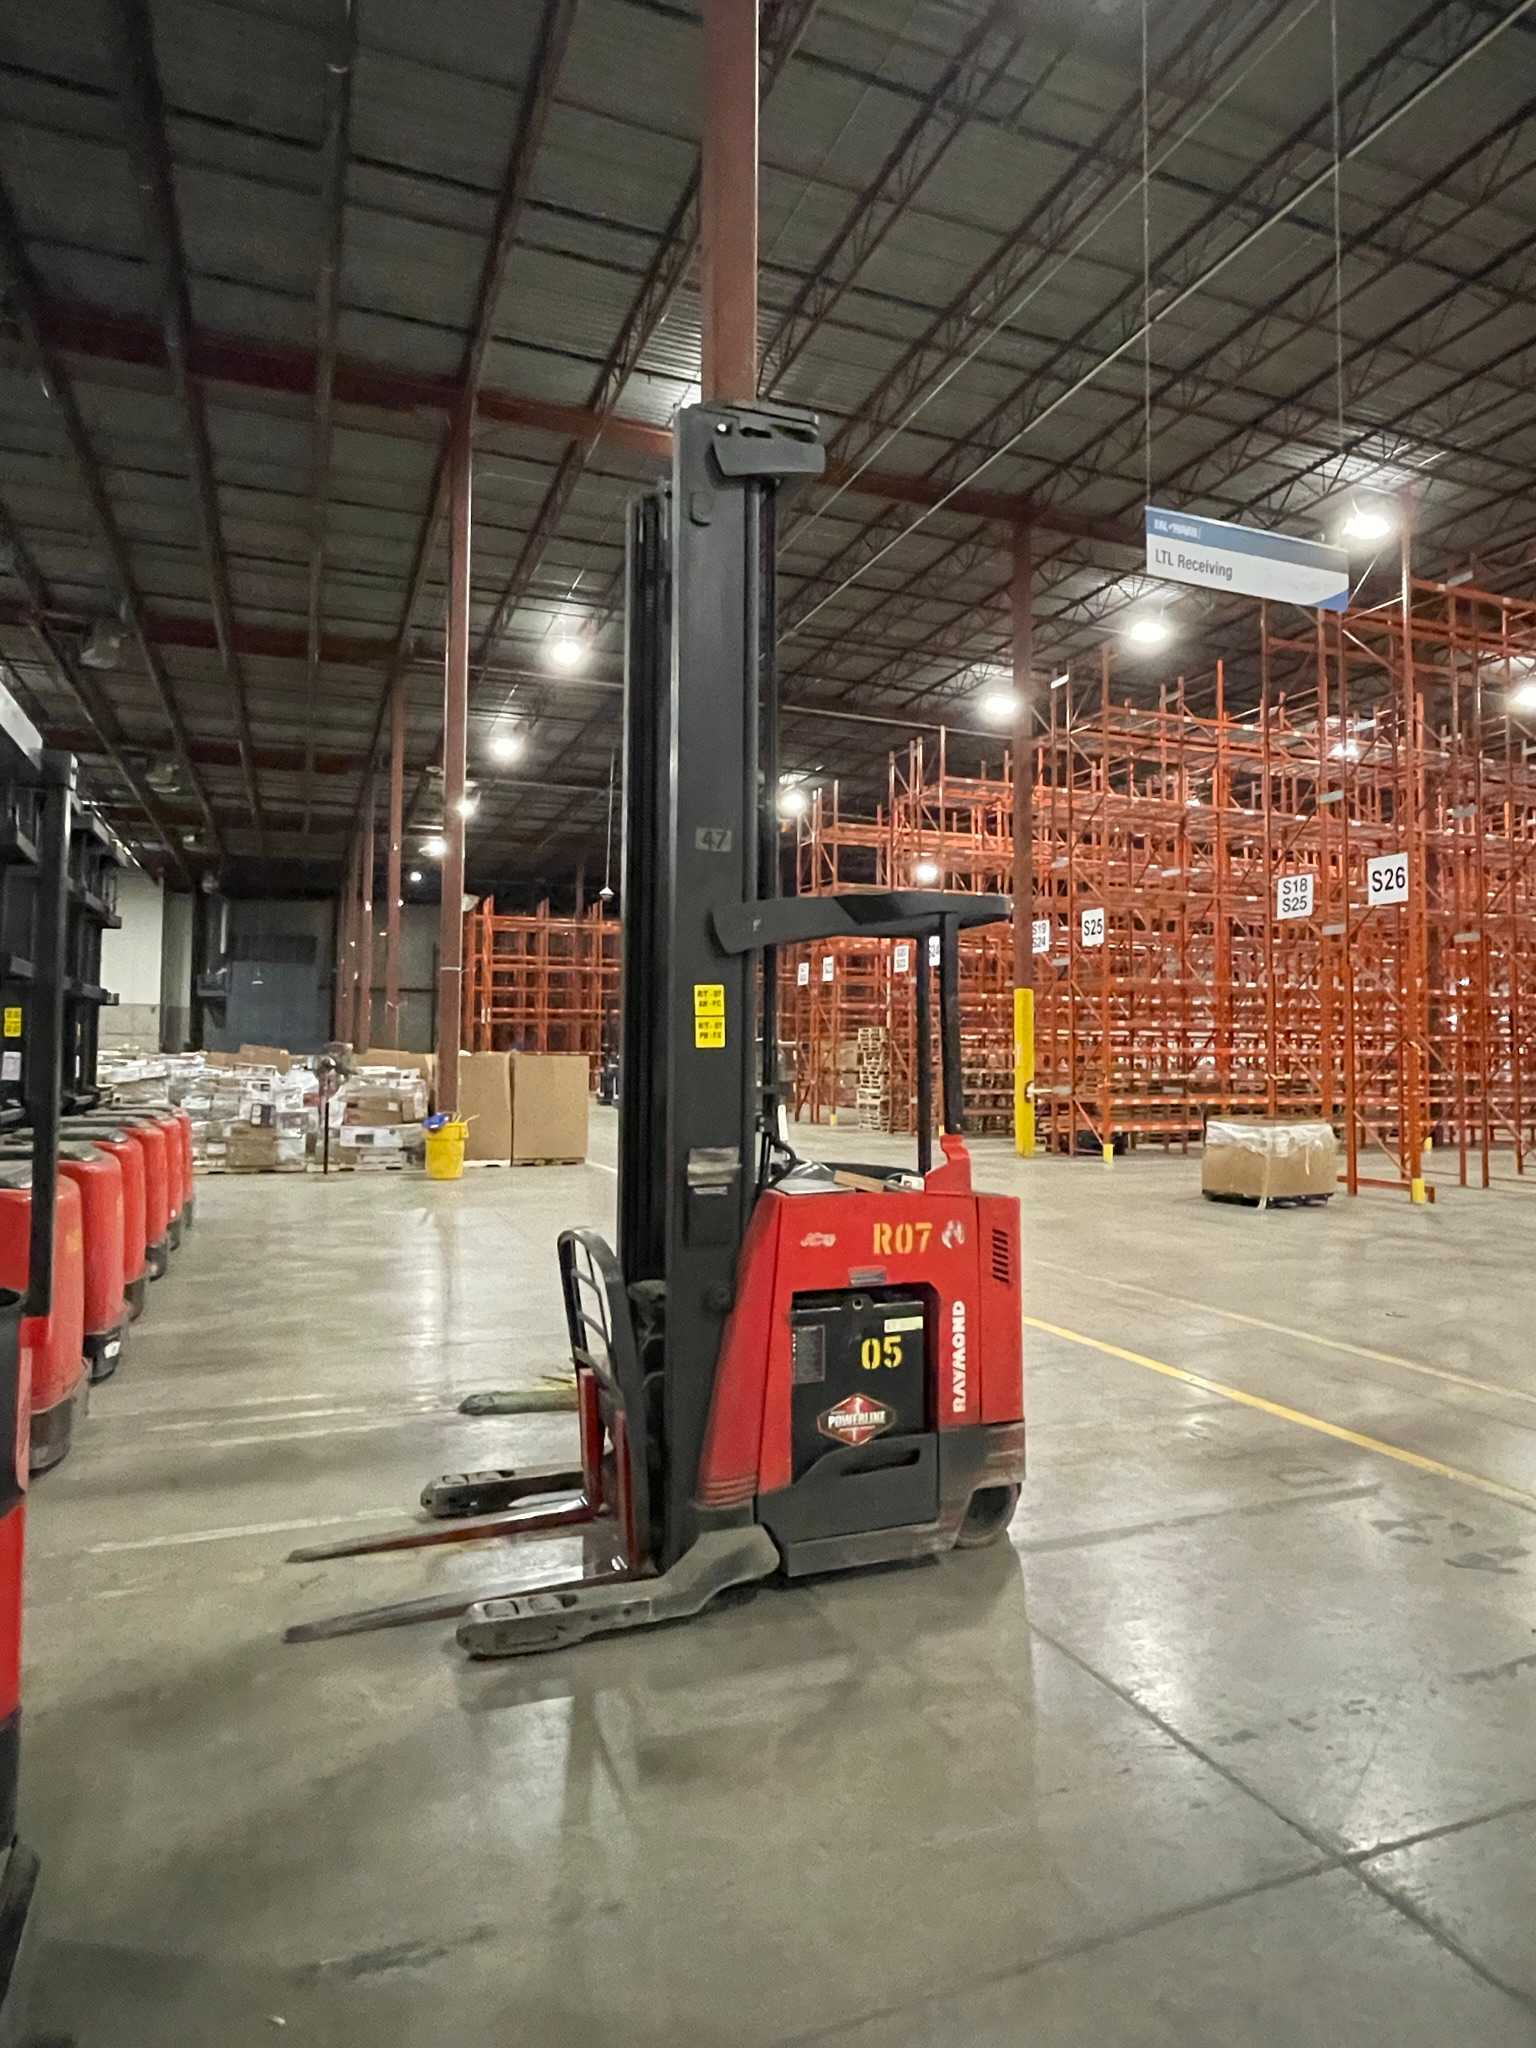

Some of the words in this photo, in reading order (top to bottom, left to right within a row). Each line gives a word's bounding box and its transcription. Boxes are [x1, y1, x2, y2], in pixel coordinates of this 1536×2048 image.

[1155, 549, 1174, 567] LTL
[1177, 553, 1233, 581] Receiving
[1282, 878, 1308, 895] S18
[1371, 866, 1406, 892] S26
[1281, 896, 1308, 913] S25
[1083, 918, 1103, 937] S25
[873, 1222, 933, 1255] R07
[861, 1335, 903, 1370] 05
[952, 1300, 967, 1413] RAYMOND
[827, 1410, 886, 1430] POWERLINE
